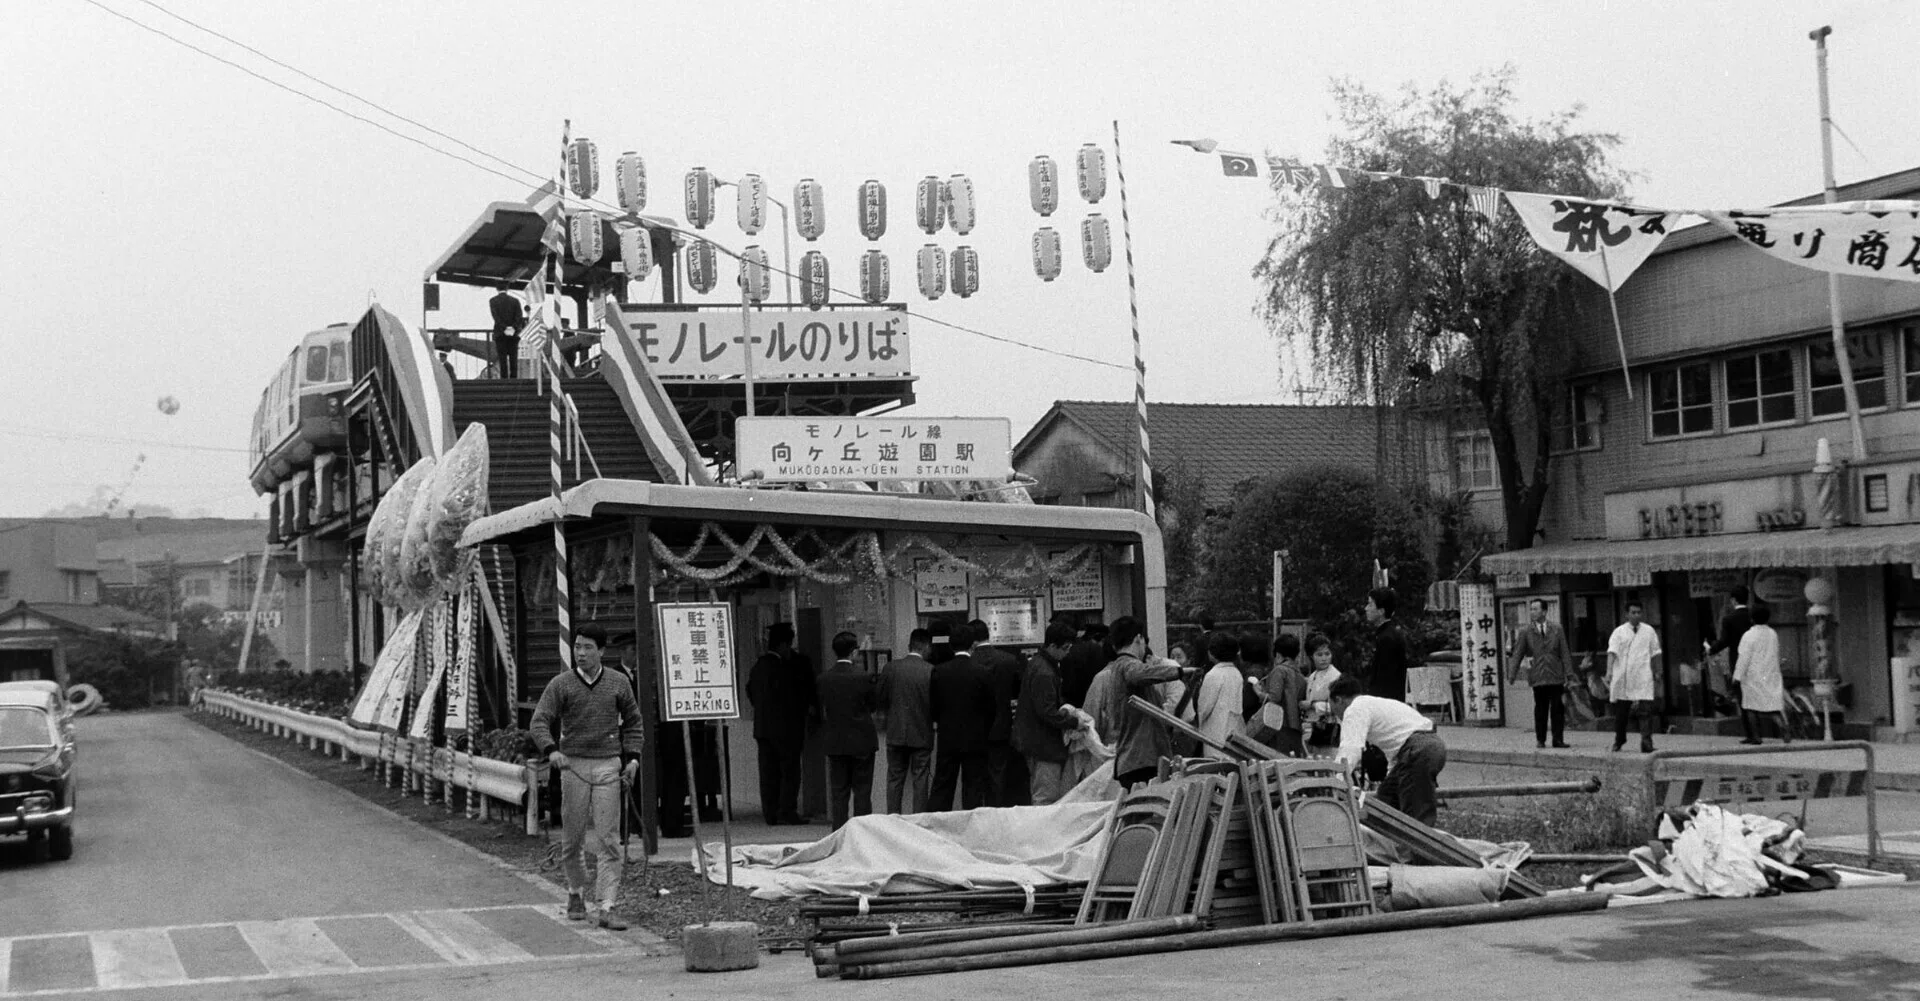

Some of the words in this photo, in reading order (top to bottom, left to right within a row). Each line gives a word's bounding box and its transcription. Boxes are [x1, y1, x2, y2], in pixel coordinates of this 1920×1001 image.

[629, 317, 900, 363] モノレールのりば
[805, 424, 942, 439] モノレール線
[917, 465, 969, 475] STATION
[688, 610, 710, 683] 駐車禁止
[671, 654, 682, 680] 駅長
[1478, 613, 1499, 713] 中和産業
[694, 690, 712, 700] NO
[675, 699, 730, 712] PARKING
